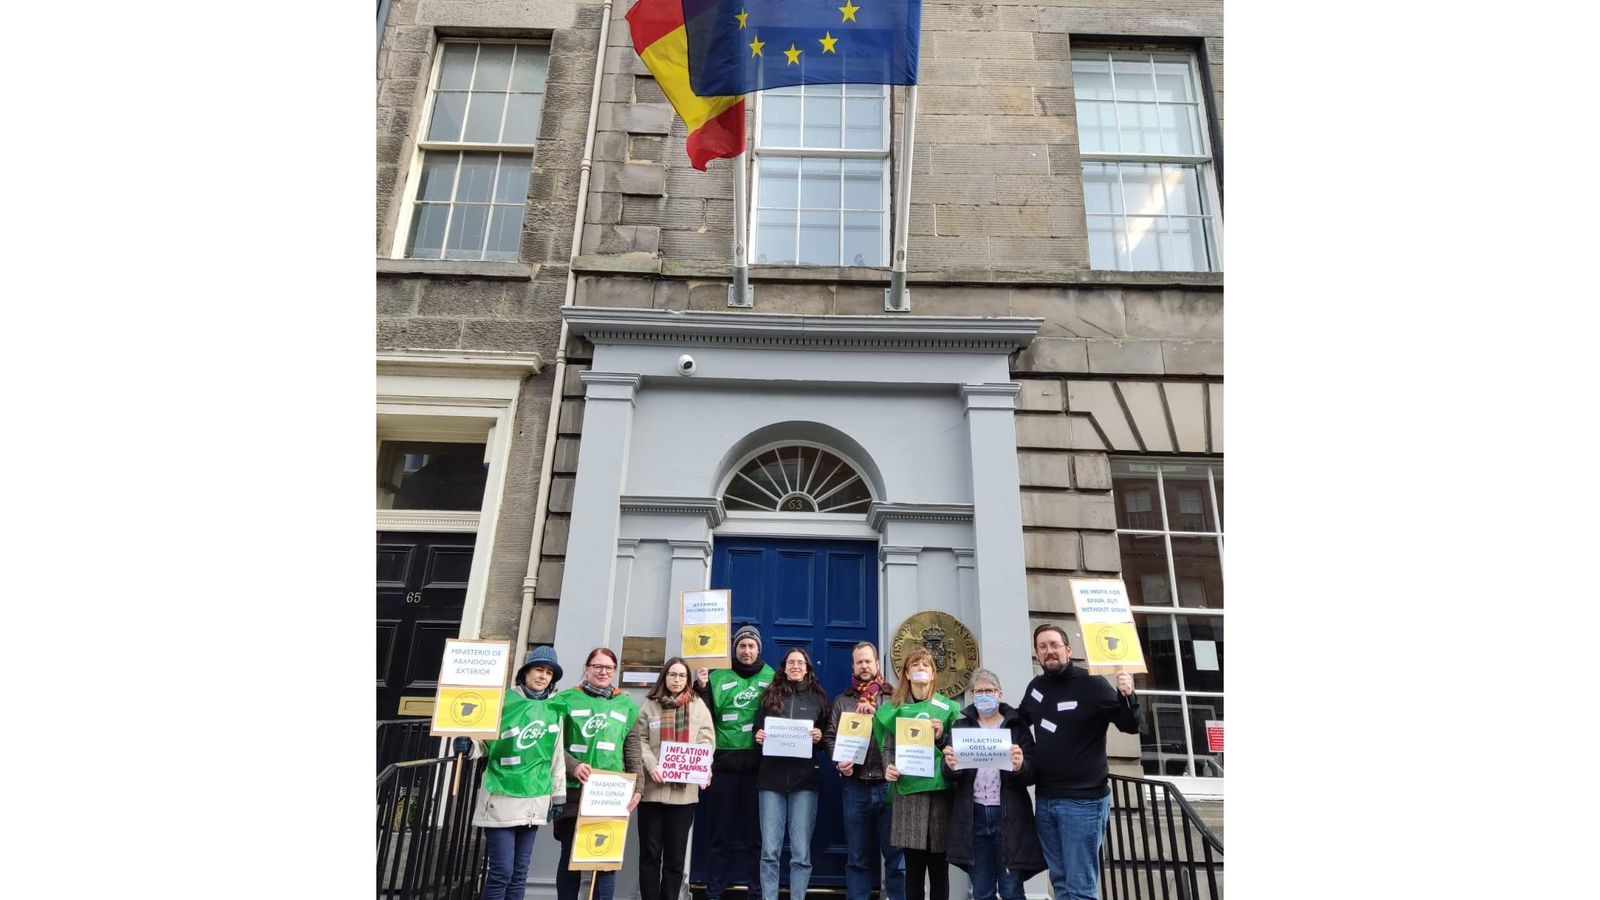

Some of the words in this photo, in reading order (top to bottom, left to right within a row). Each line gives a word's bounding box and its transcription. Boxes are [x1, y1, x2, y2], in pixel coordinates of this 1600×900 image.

[789, 499, 802, 510] 63
[406, 591, 421, 603] 65
[451, 648, 490, 656] MINISTERIO
[453, 658, 497, 666] ABANDONO
[456, 667, 490, 675] EXTERIOR
[666, 745, 709, 756] INFLATION
[665, 754, 686, 763] GOES
[690, 756, 701, 764] UP
[678, 764, 708, 773] SALARIES
[662, 770, 690, 779] DON'T
[592, 780, 626, 788] TRABAJAMOS
